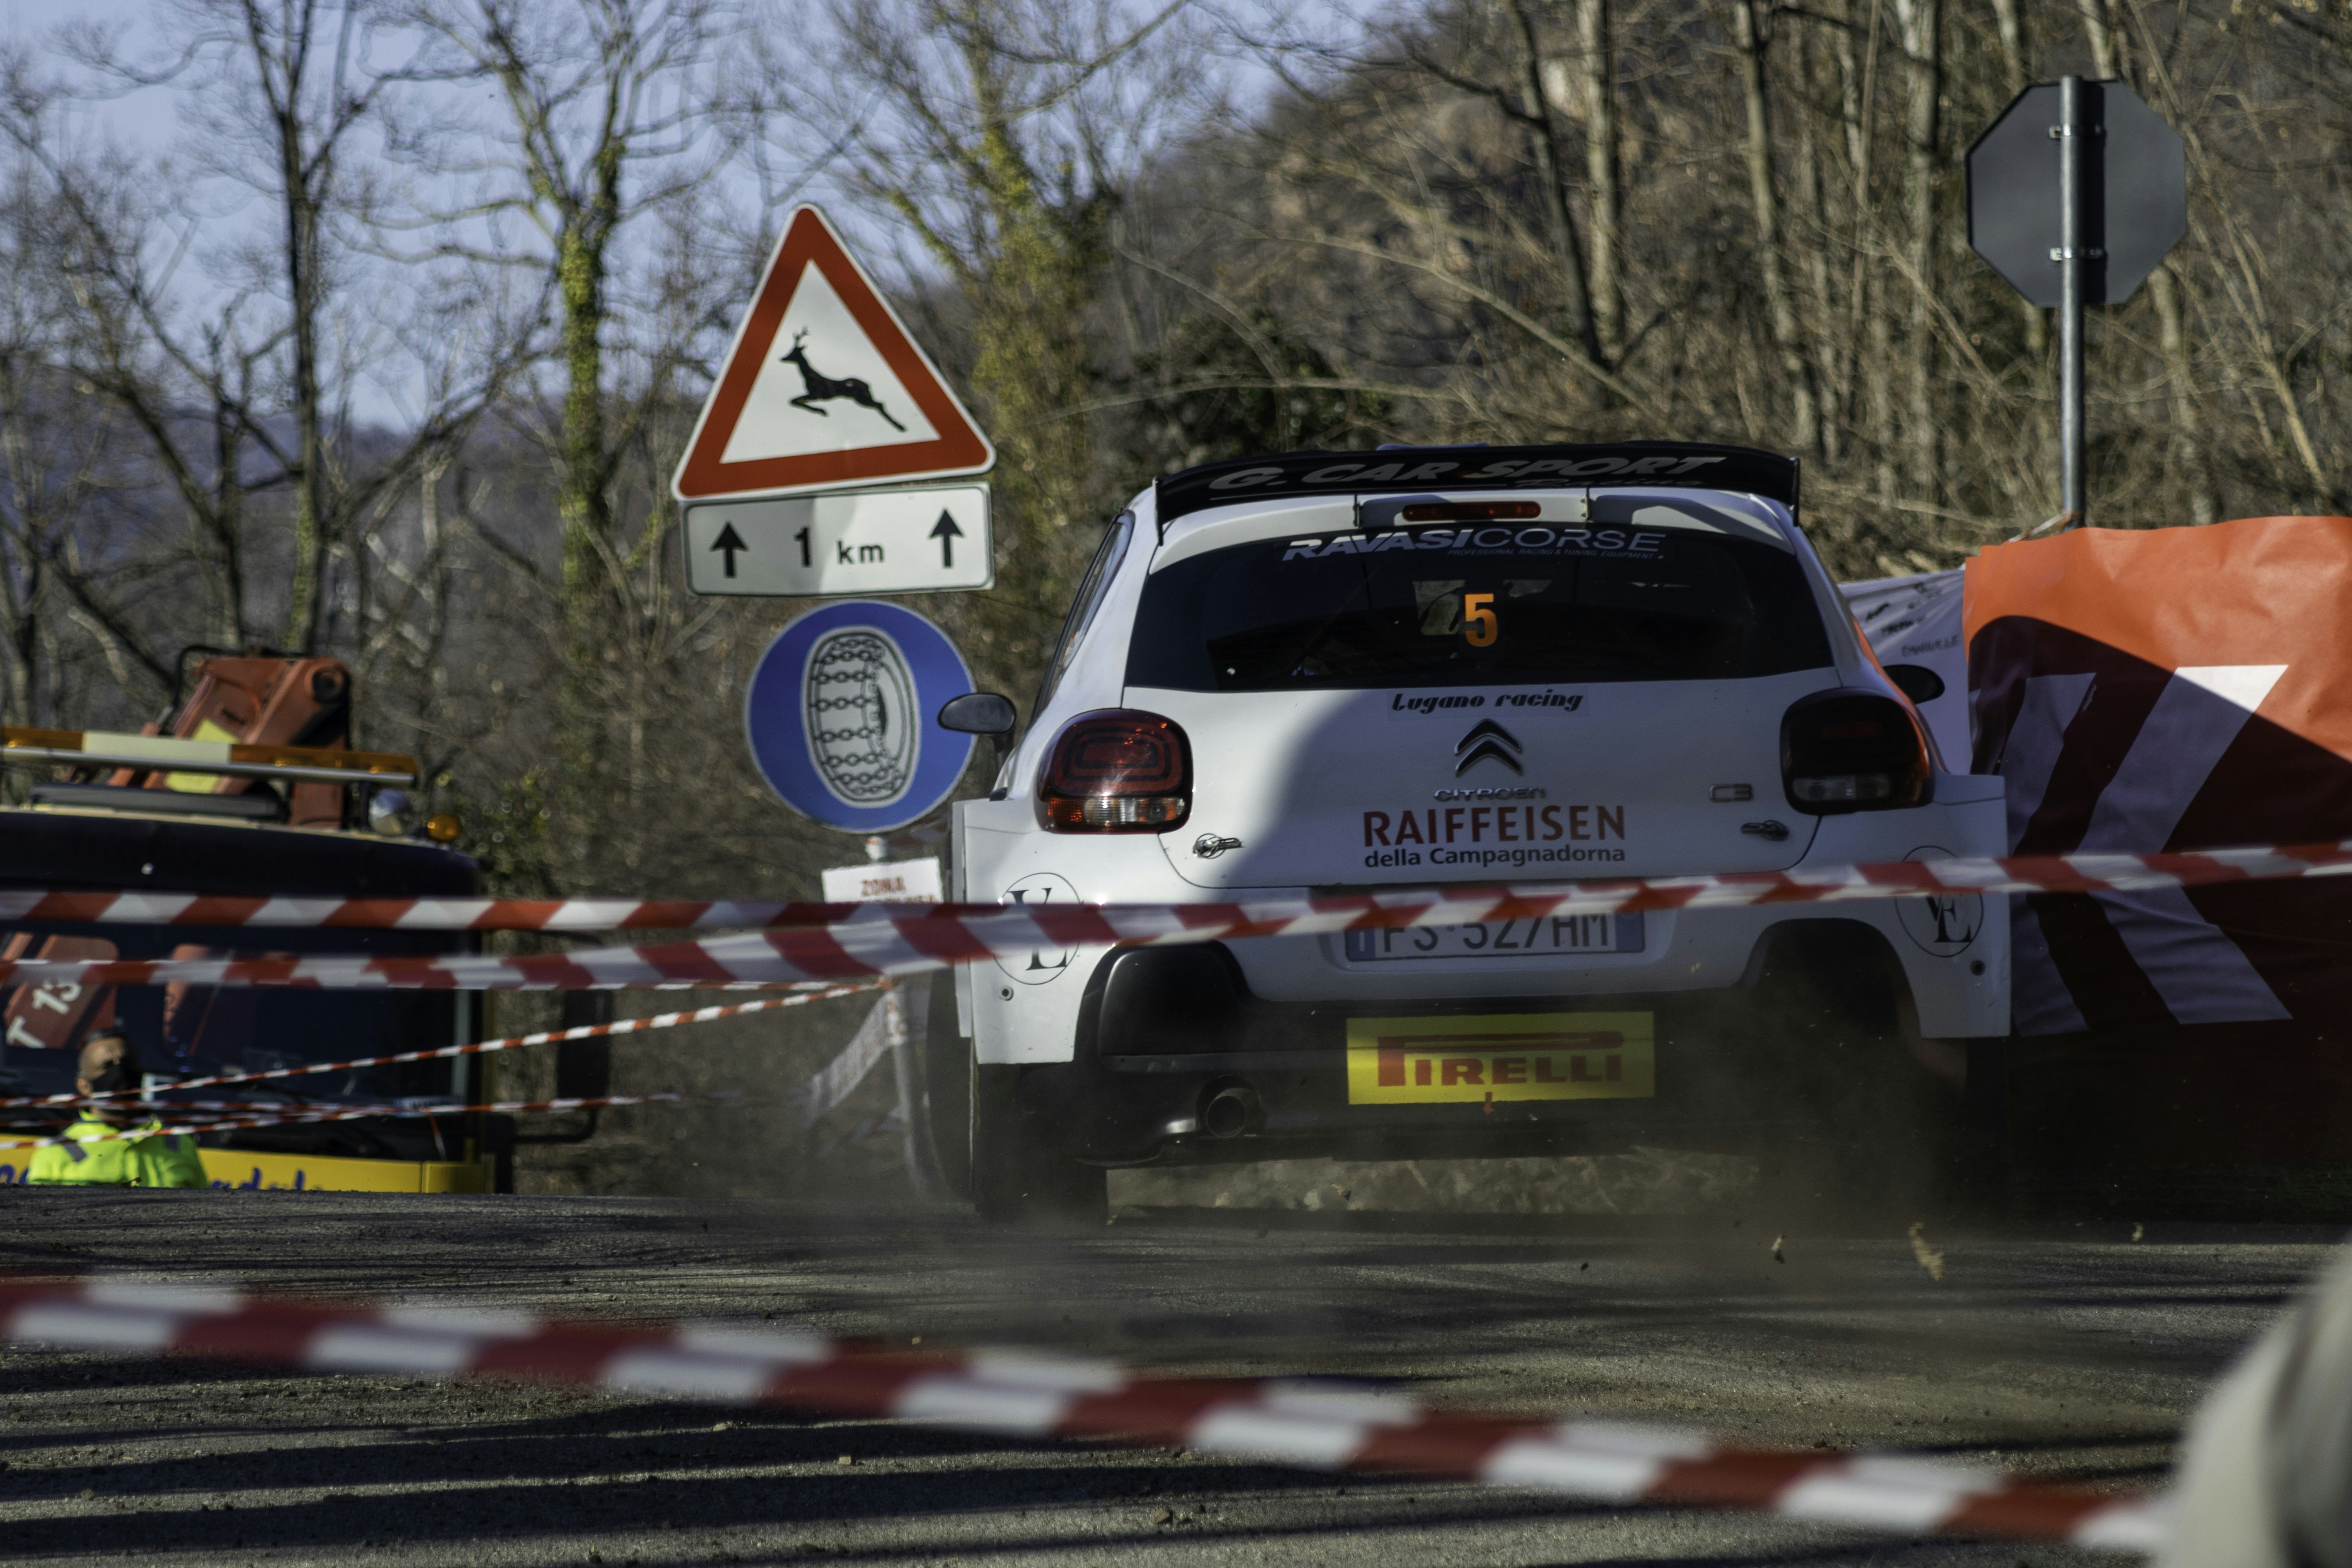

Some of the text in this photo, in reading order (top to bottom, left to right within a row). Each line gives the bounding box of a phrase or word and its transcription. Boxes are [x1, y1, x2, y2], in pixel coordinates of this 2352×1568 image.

[1301, 462, 1460, 483] CAR
[1462, 457, 1726, 478] SPORT
[794, 527, 885, 567] 1 km
[1464, 592, 1498, 647] 5
[1392, 689, 1584, 714] Lugano racing
[1709, 784, 1753, 803] C3
[1364, 805, 1626, 847] RAIFFEISEN
[1364, 844, 1626, 868] della Campagnadorna
[1378, 1031, 1624, 1087] PIRELLI
